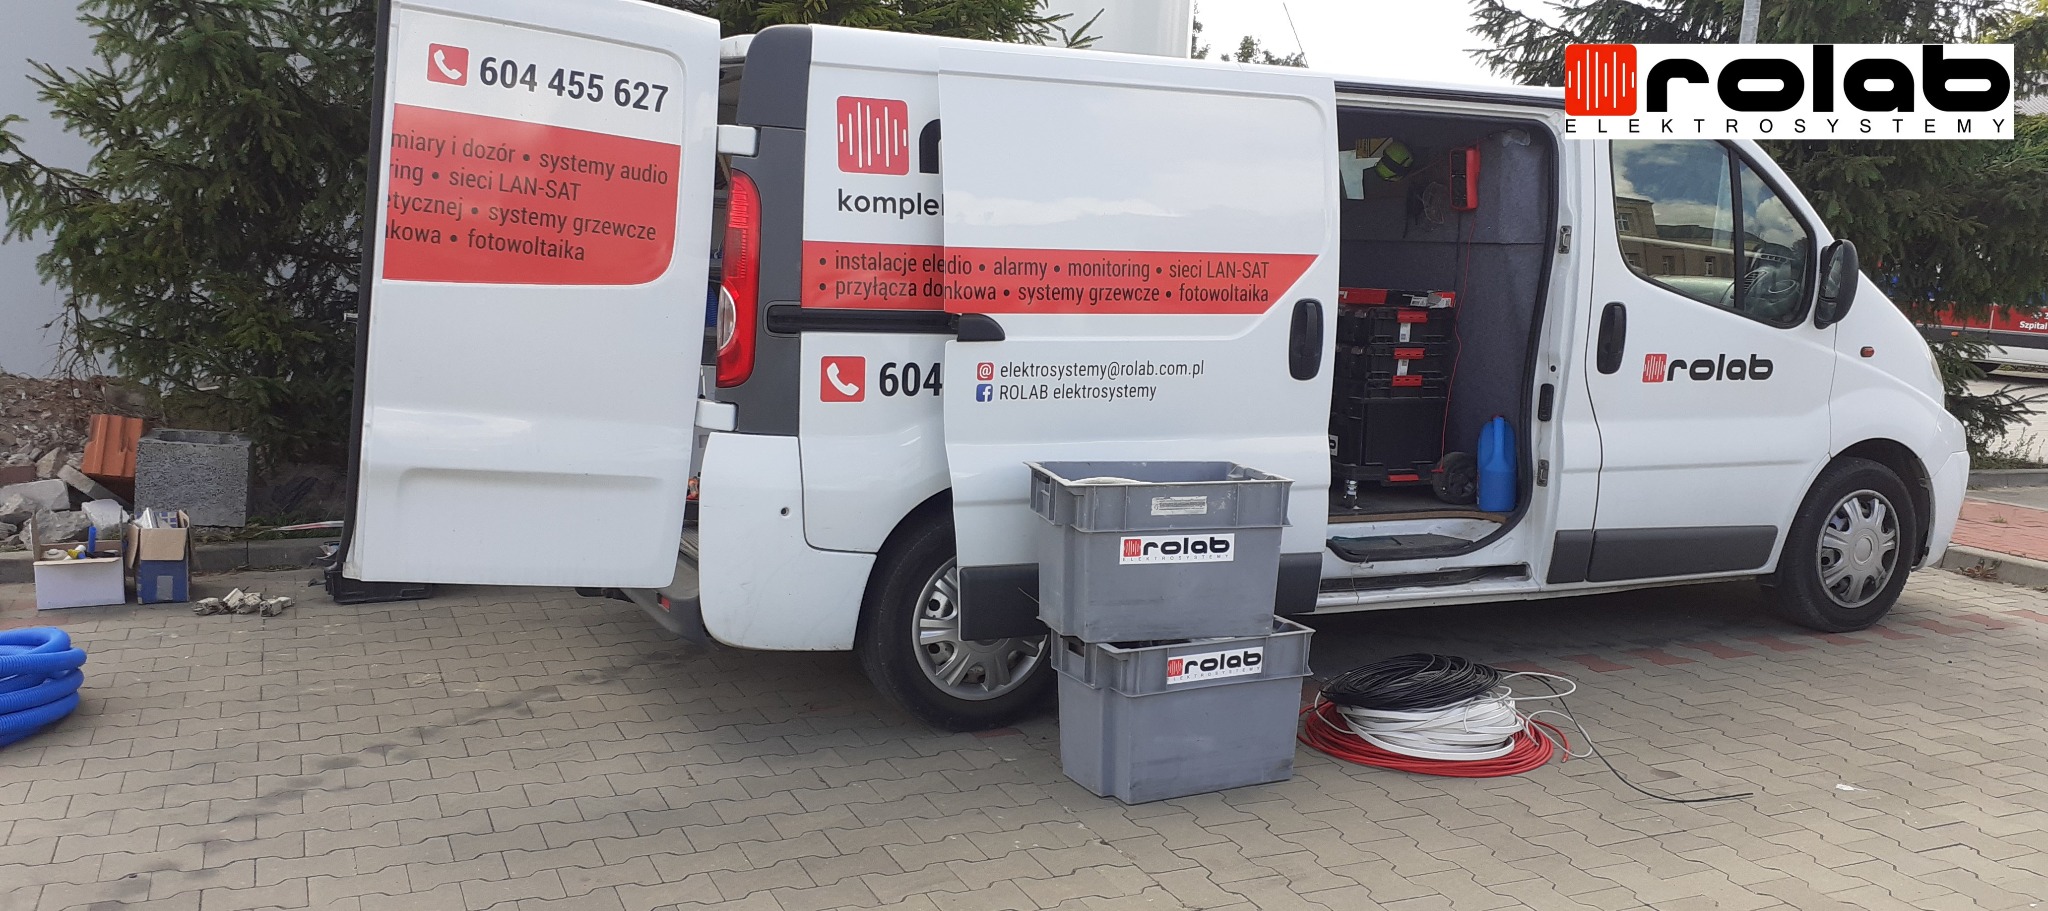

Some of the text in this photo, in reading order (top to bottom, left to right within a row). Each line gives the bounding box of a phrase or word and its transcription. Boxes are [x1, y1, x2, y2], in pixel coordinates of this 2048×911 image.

[480, 56, 669, 113] 604 455 627
[452, 135, 456, 156] i
[462, 138, 516, 163] dozór
[539, 151, 615, 182] systemy
[620, 165, 668, 186] audio
[449, 166, 493, 190] sieci
[499, 173, 581, 202] LAN-SAT
[838, 188, 944, 220] komple
[488, 206, 568, 236] systemy
[572, 216, 657, 242] grzewcze
[468, 228, 585, 261] fotowoltaika
[835, 250, 917, 276] instalacje
[994, 255, 1048, 281] alarmy
[1068, 258, 1150, 284] monitoring
[1169, 260, 1203, 279] sieci
[1208, 261, 1270, 279] LAN-SAT
[835, 276, 917, 301] przyłącza
[1017, 281, 1084, 306] systemy
[1089, 286, 1160, 306] grzewcze
[1179, 283, 1269, 302] fotowoltaika
[2019, 320, 2048, 331] Szpital
[879, 362, 943, 397] 604
[1000, 361, 1205, 381] elektrosystemy@rolab.com.pl
[1667, 353, 1774, 382] rolab
[999, 385, 1049, 401] ROLAB
[1053, 384, 1157, 402] elektrosystemy
[1143, 537, 1230, 555] rolab
[1184, 651, 1261, 674] rolab
